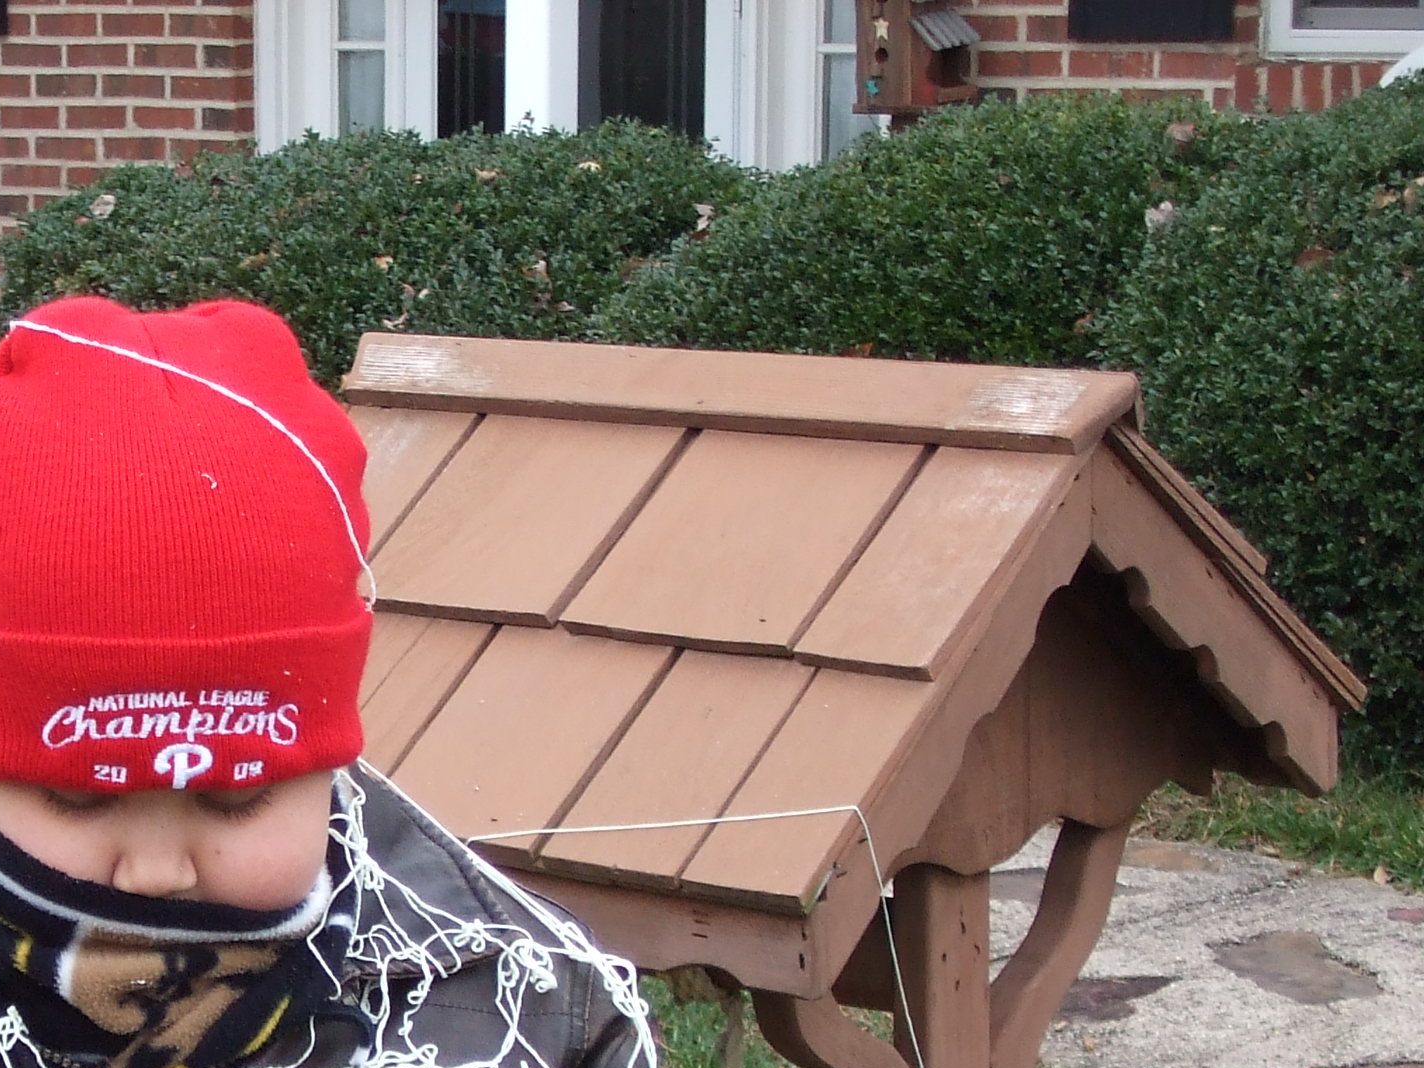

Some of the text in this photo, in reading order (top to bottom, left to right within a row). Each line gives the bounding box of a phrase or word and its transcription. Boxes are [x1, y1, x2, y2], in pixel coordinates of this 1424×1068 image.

[87, 689, 270, 712] NATIONAL LEAGUE
[42, 703, 299, 748] Champions
[94, 764, 127, 784] 20
[153, 743, 213, 790] P
